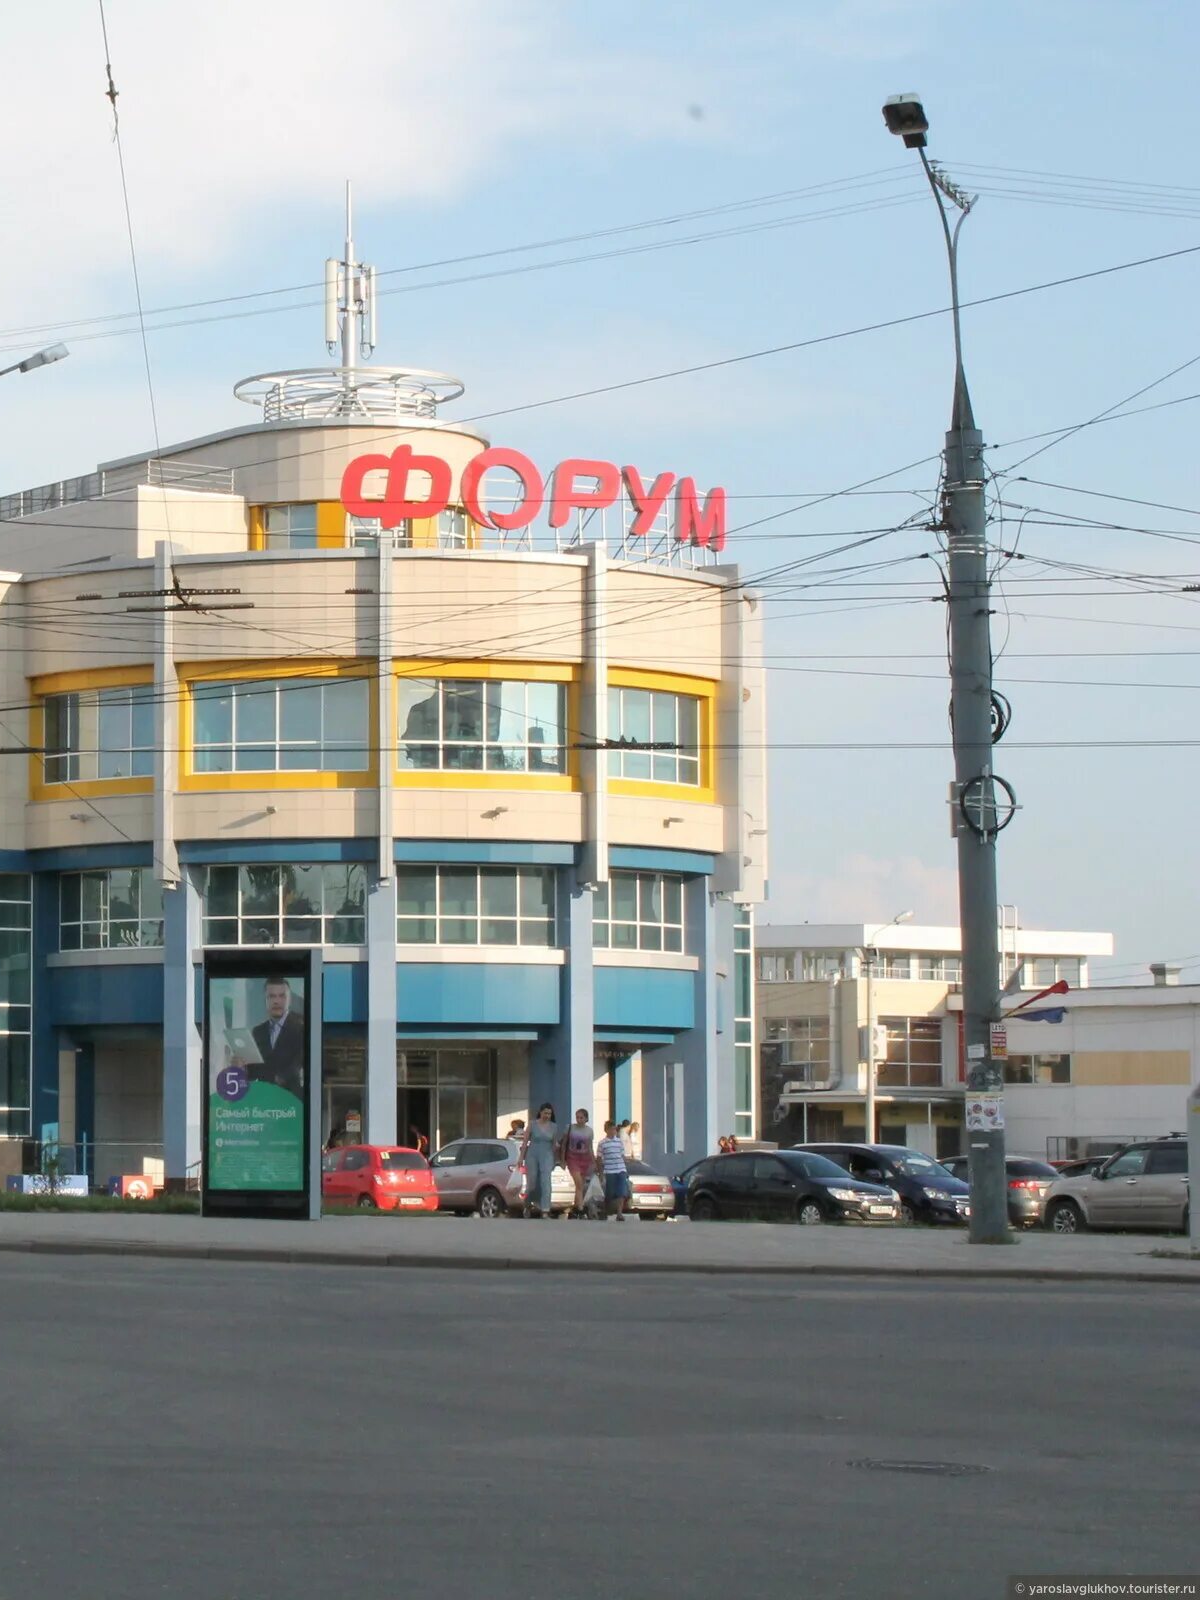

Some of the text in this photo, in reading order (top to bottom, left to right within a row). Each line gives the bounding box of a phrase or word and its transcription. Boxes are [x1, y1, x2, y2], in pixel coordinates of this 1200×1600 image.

[340, 444, 728, 552] ФОРУМ
[226, 1072, 239, 1095] 5
[215, 1106, 296, 1120] Самый быстрый
[215, 1121, 264, 1133] Интернет
